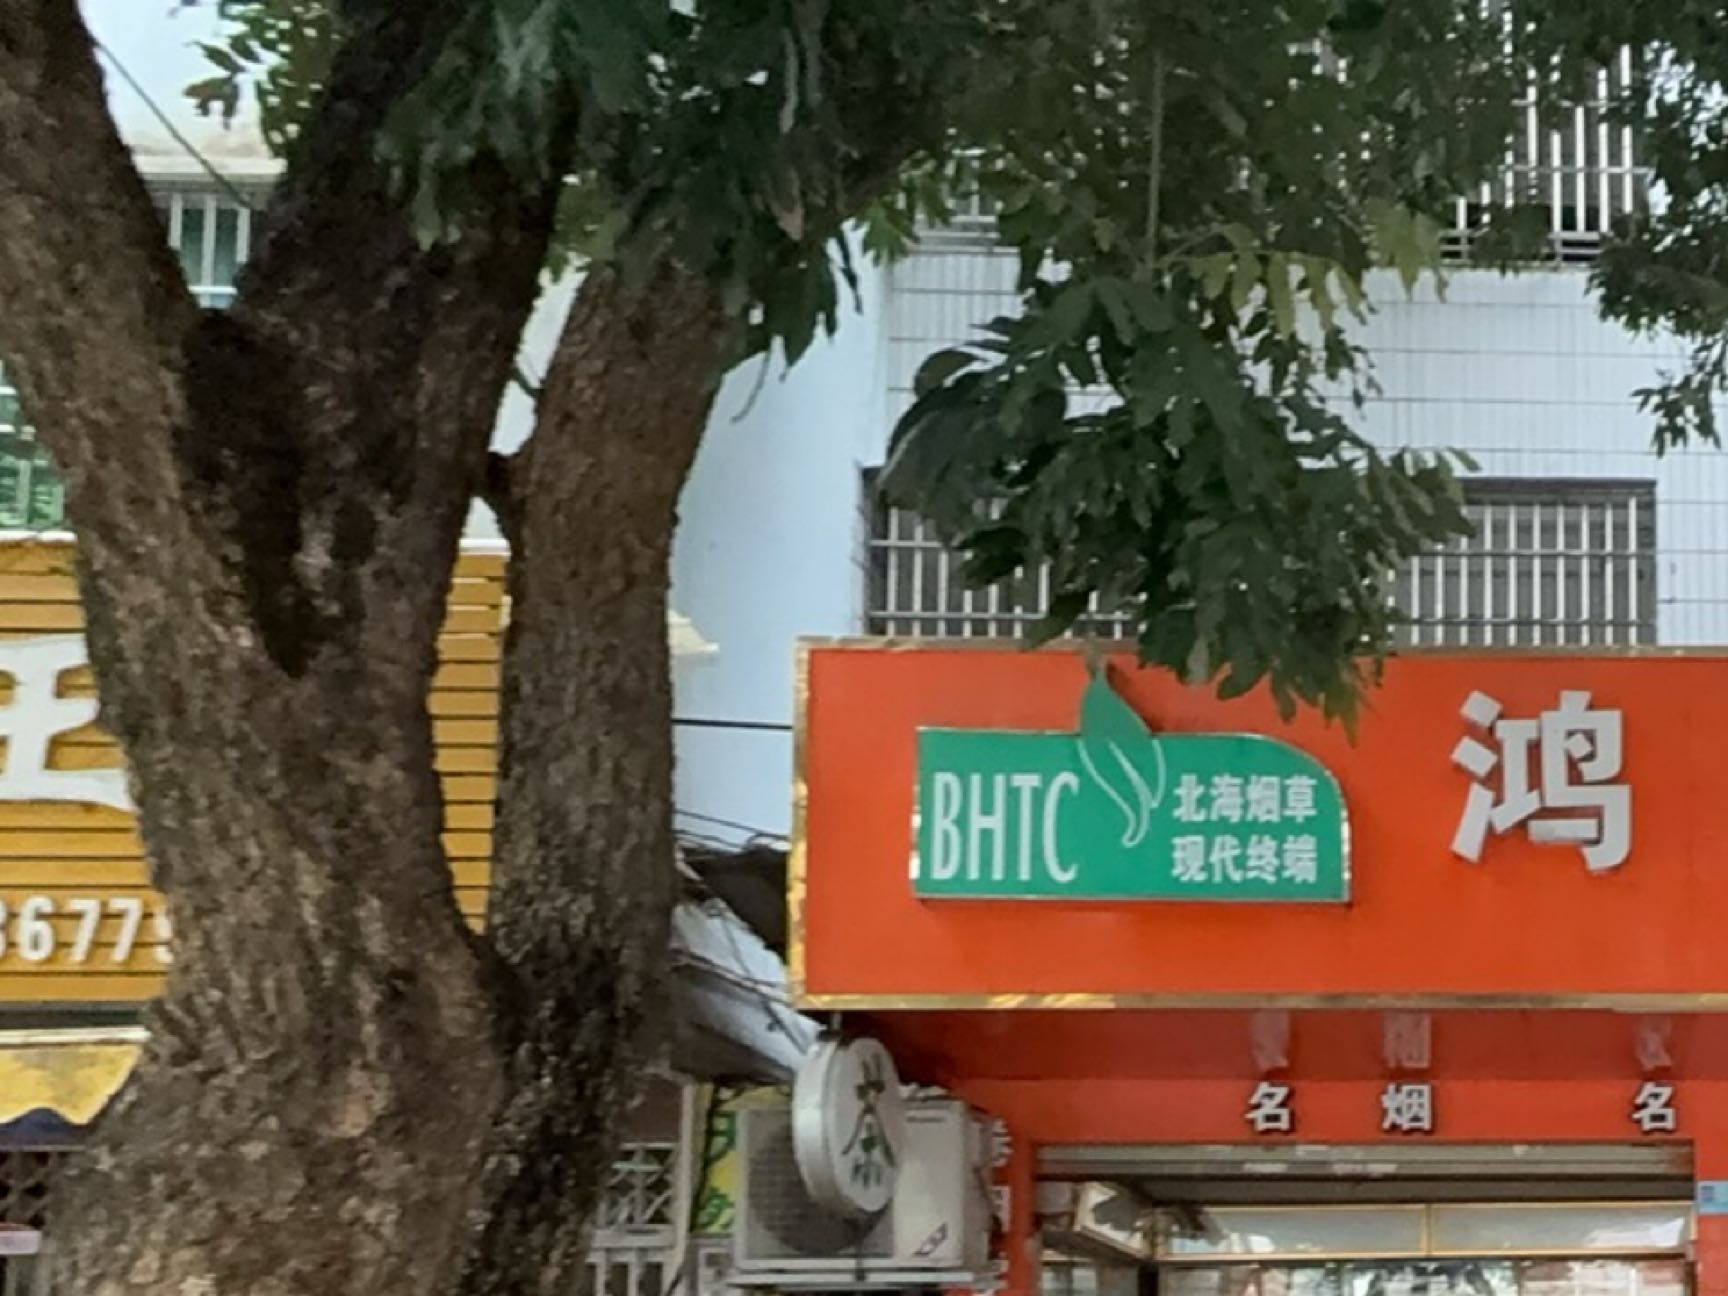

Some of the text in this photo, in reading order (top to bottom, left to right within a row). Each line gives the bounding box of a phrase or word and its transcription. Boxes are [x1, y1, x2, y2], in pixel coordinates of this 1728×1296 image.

[1172, 773, 1319, 824] 北海烟草
[929, 770, 1081, 883] BHTC
[1170, 834, 1320, 885] 现代终端
[0, 894, 175, 964] 677
[1244, 1082, 1436, 1134] 名烟
